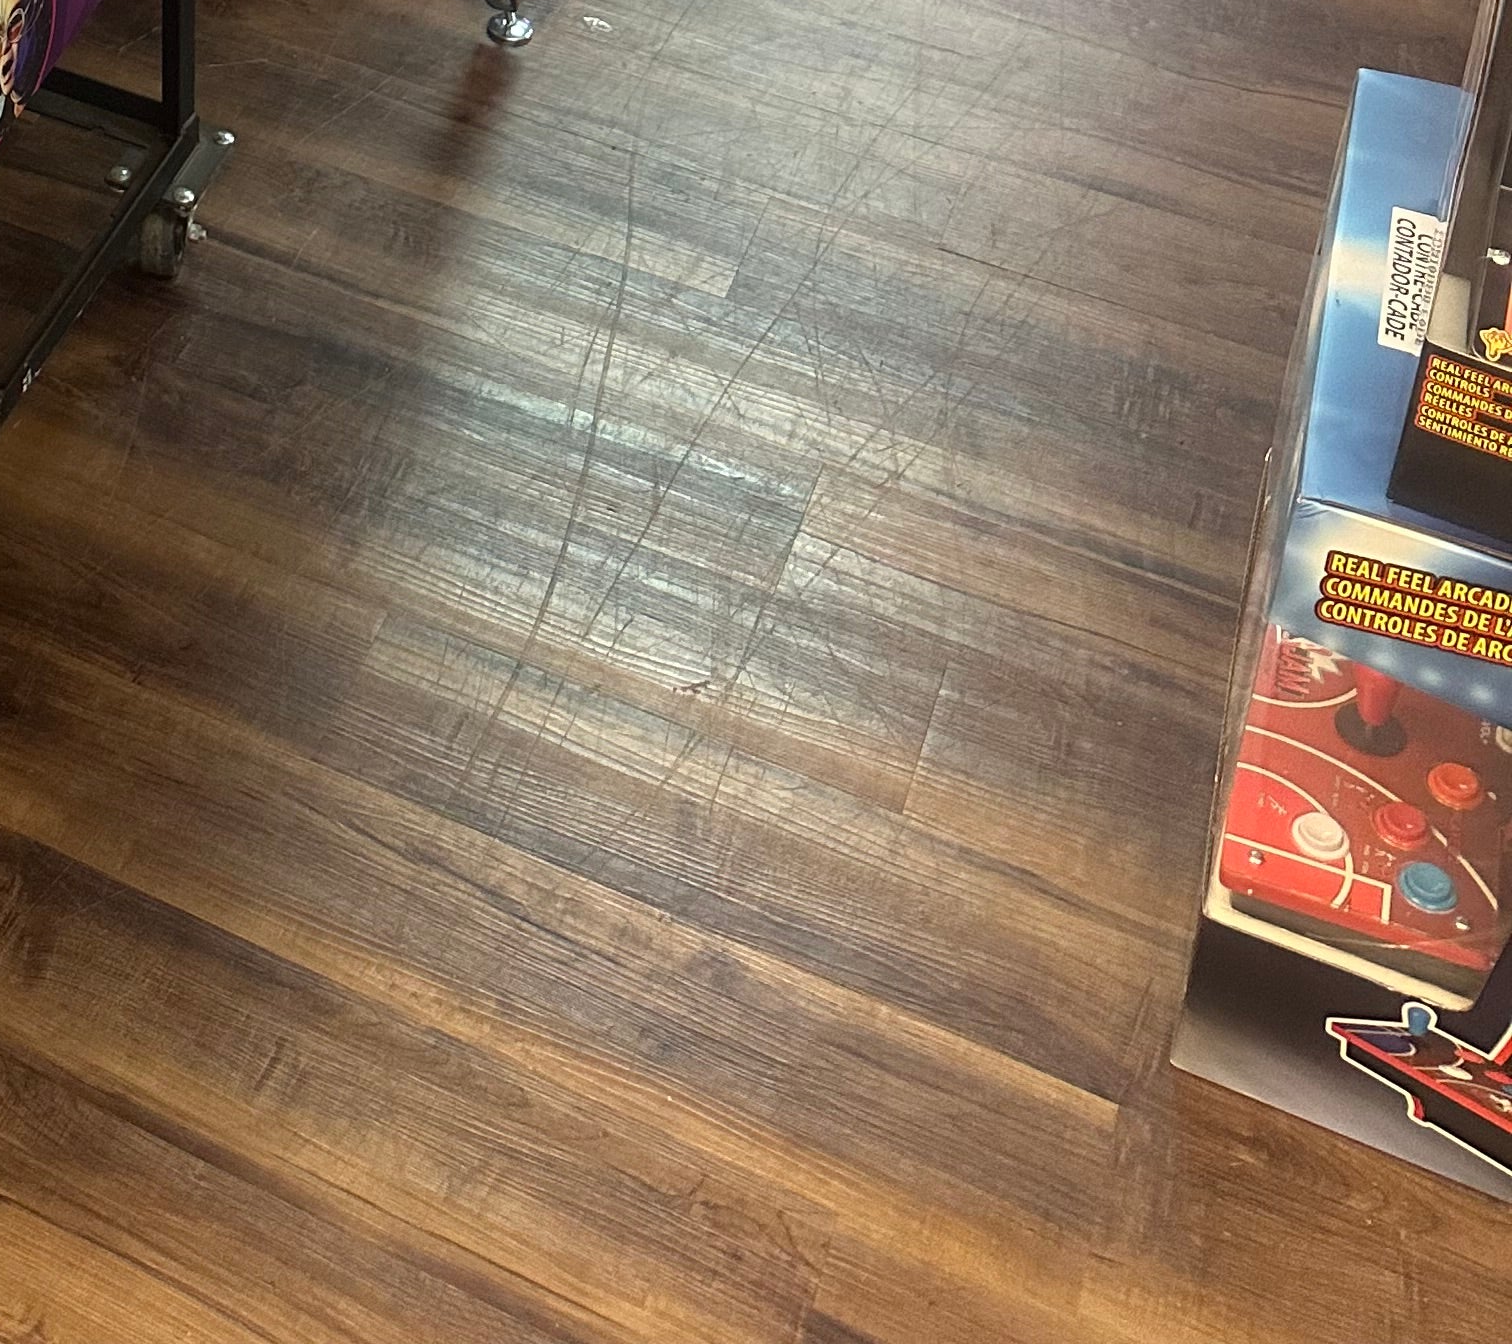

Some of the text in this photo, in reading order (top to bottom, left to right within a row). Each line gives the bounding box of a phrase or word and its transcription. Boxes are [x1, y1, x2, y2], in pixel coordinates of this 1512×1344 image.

[1384, 217, 1416, 342] CONTADOR-CADE
[1429, 369, 1490, 397] CONTROLS
[1432, 358, 1461, 376] REAL
[1464, 370, 1490, 386] FEEL
[1427, 382, 1502, 416] COMMANDES
[1418, 416, 1497, 451] SENTIMIENTO
[1421, 405, 1487, 437] CONTROLES
[1490, 430, 1506, 444] DE
[1331, 553, 1381, 581] REAL
[1386, 567, 1433, 593] FEEL
[1326, 578, 1458, 623] COMMANDES
[1462, 609, 1491, 632] DE
[1321, 600, 1438, 642] CONTROLES
[1441, 629, 1471, 651] DE
